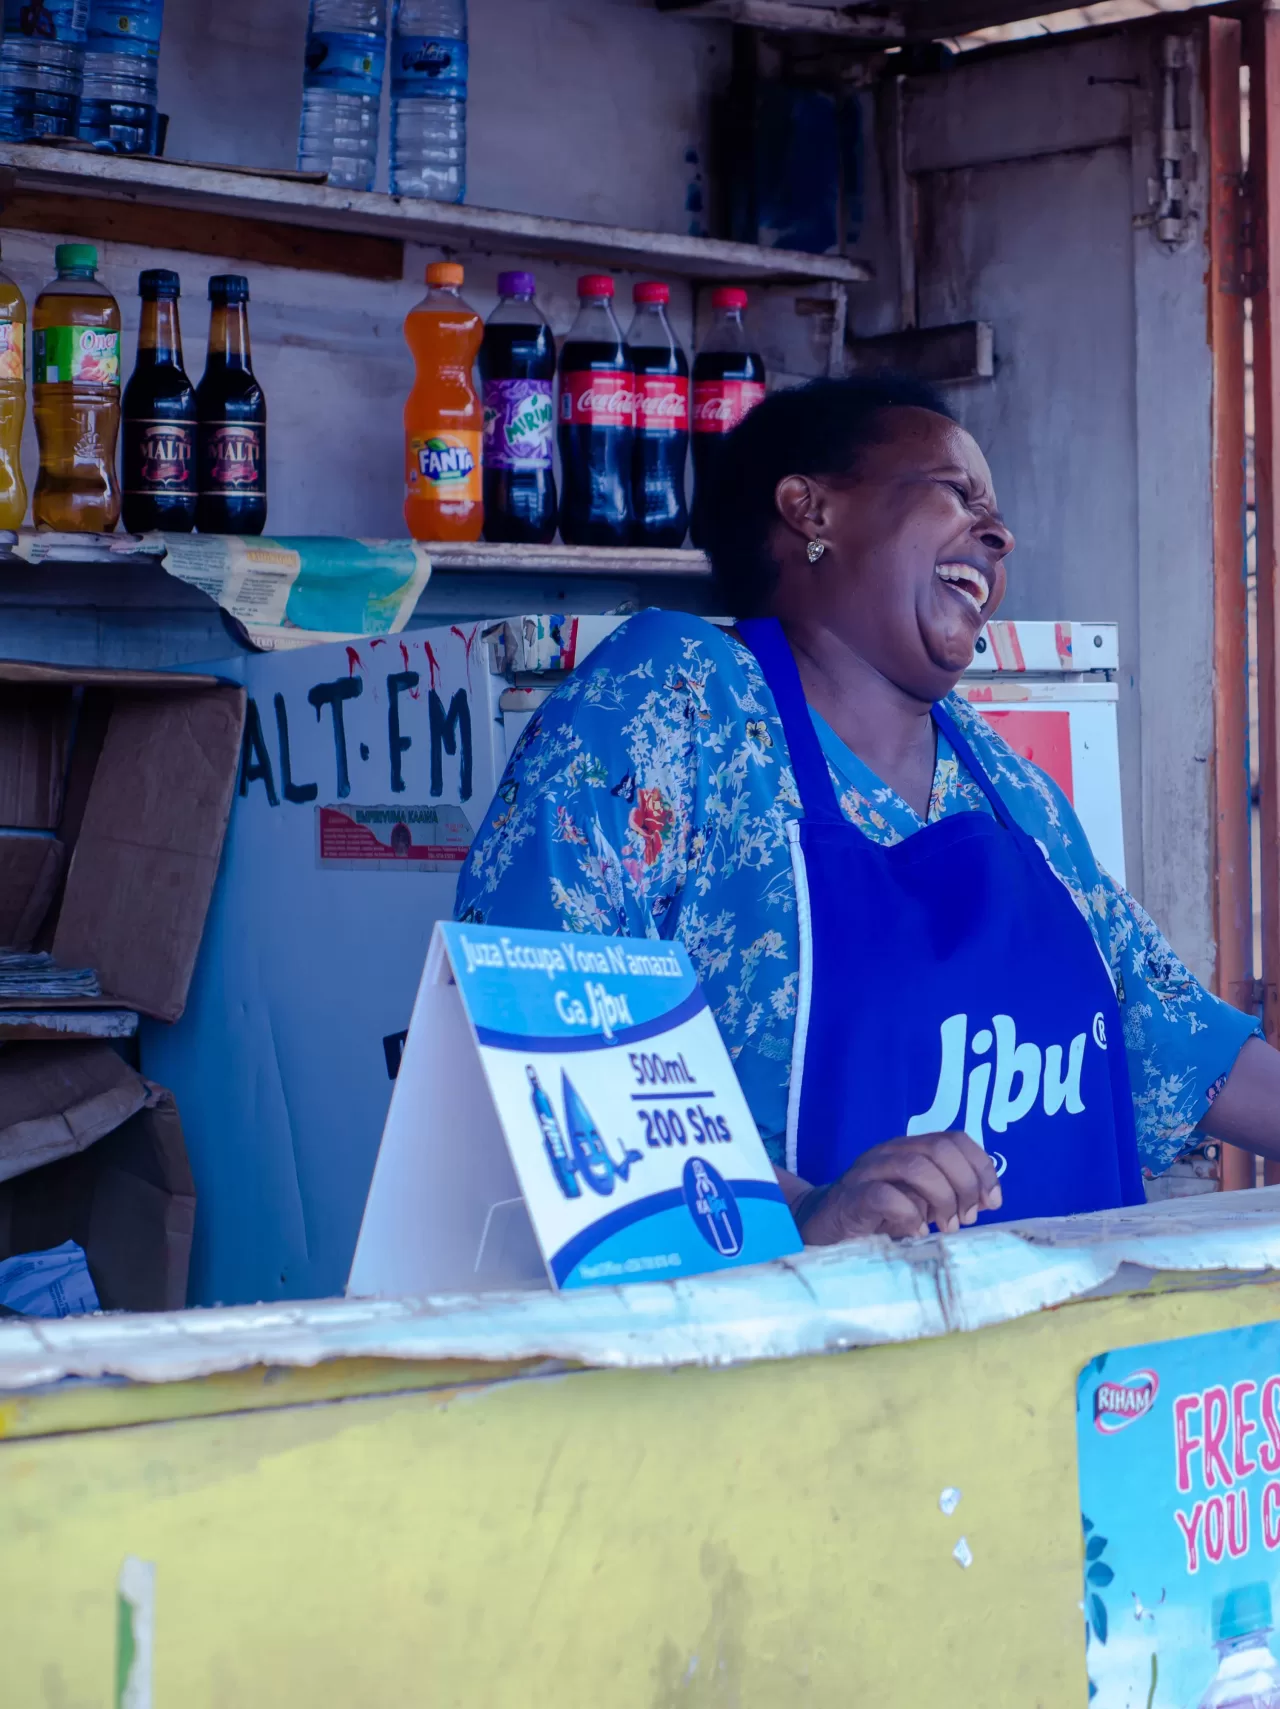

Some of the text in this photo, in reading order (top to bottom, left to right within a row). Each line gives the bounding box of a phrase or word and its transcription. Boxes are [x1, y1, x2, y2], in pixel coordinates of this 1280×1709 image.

[419, 446, 475, 473] FANTA
[459, 934, 684, 980] Juza Eccupa Yona N'amazzi
[554, 980, 635, 1040] Ga Jibu
[906, 1013, 1087, 1151] Jibu
[636, 1103, 732, 1149] 200 Shs
[1099, 1386, 1151, 1412] RIHAM
[1175, 1489, 1248, 1571] YOU
